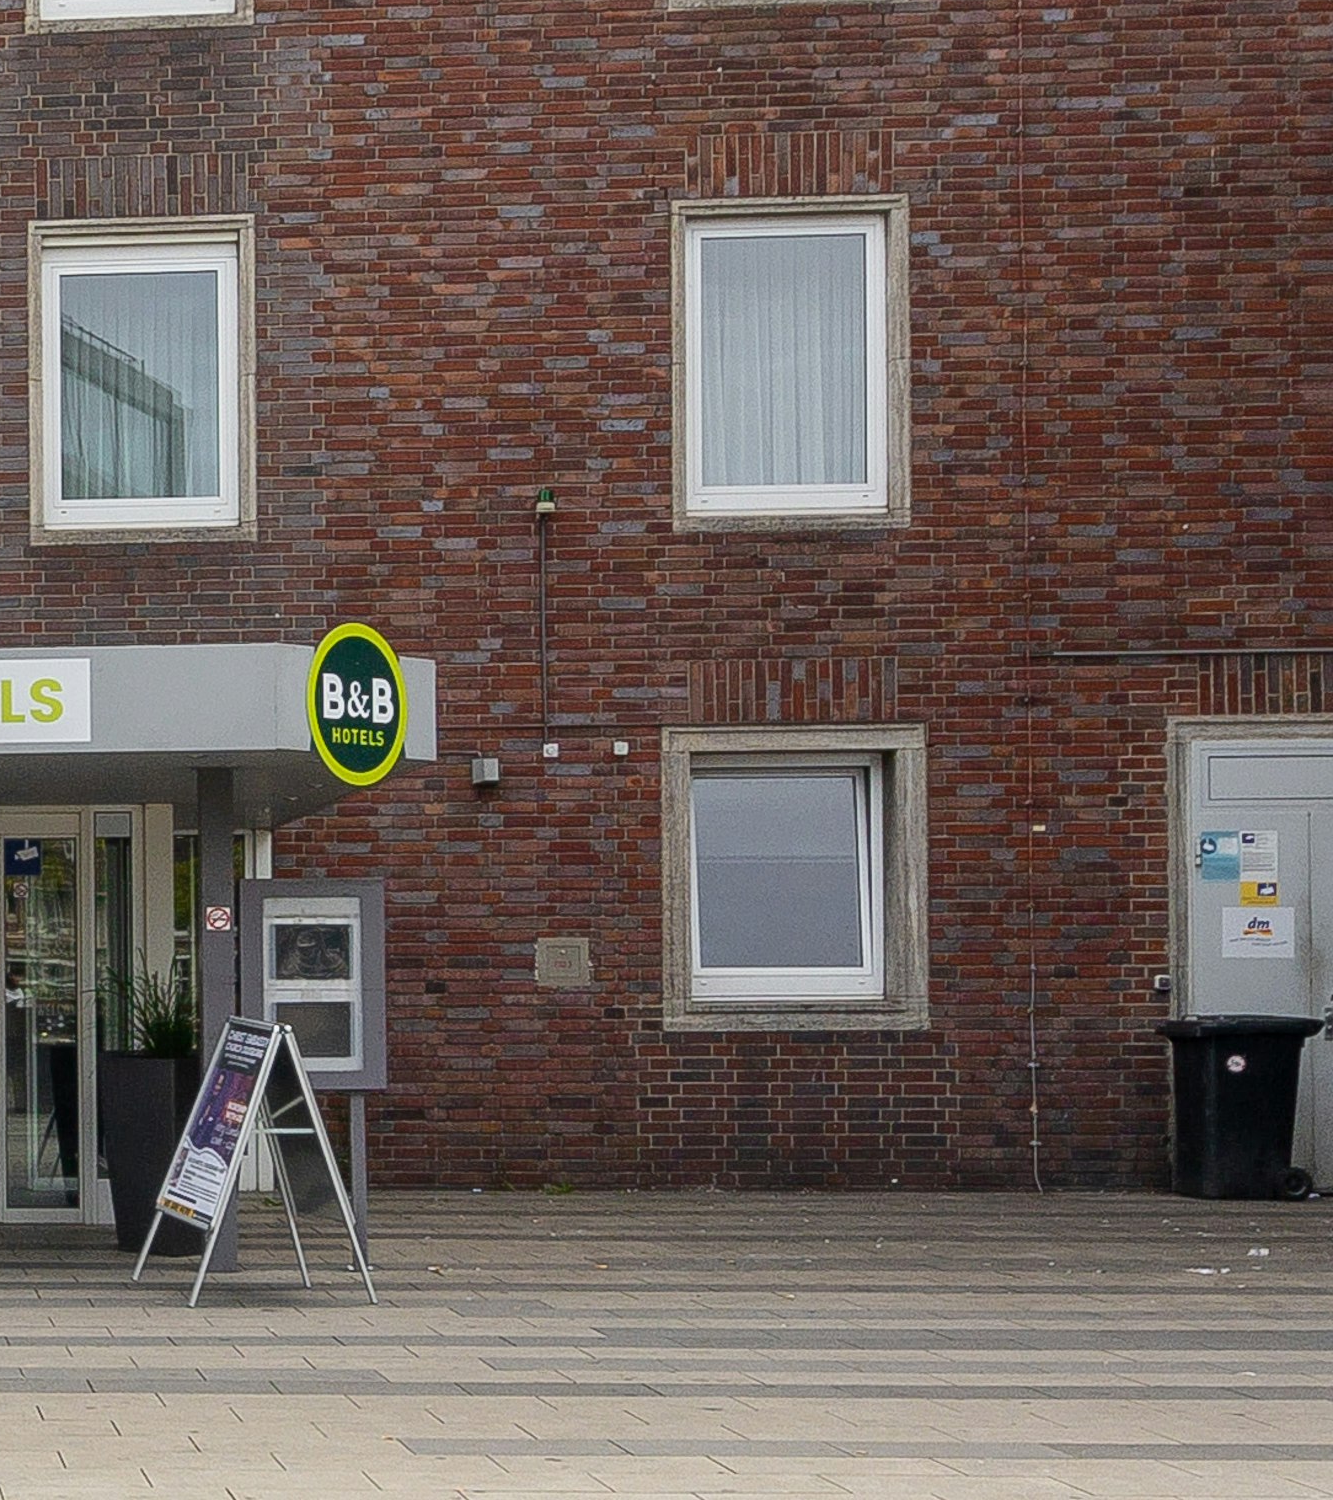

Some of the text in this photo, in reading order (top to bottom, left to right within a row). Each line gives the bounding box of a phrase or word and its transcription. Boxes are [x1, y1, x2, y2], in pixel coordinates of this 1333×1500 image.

[322, 673, 395, 724] B&B
[332, 727, 384, 747] HOTELS
[1247, 916, 1270, 930] dm
